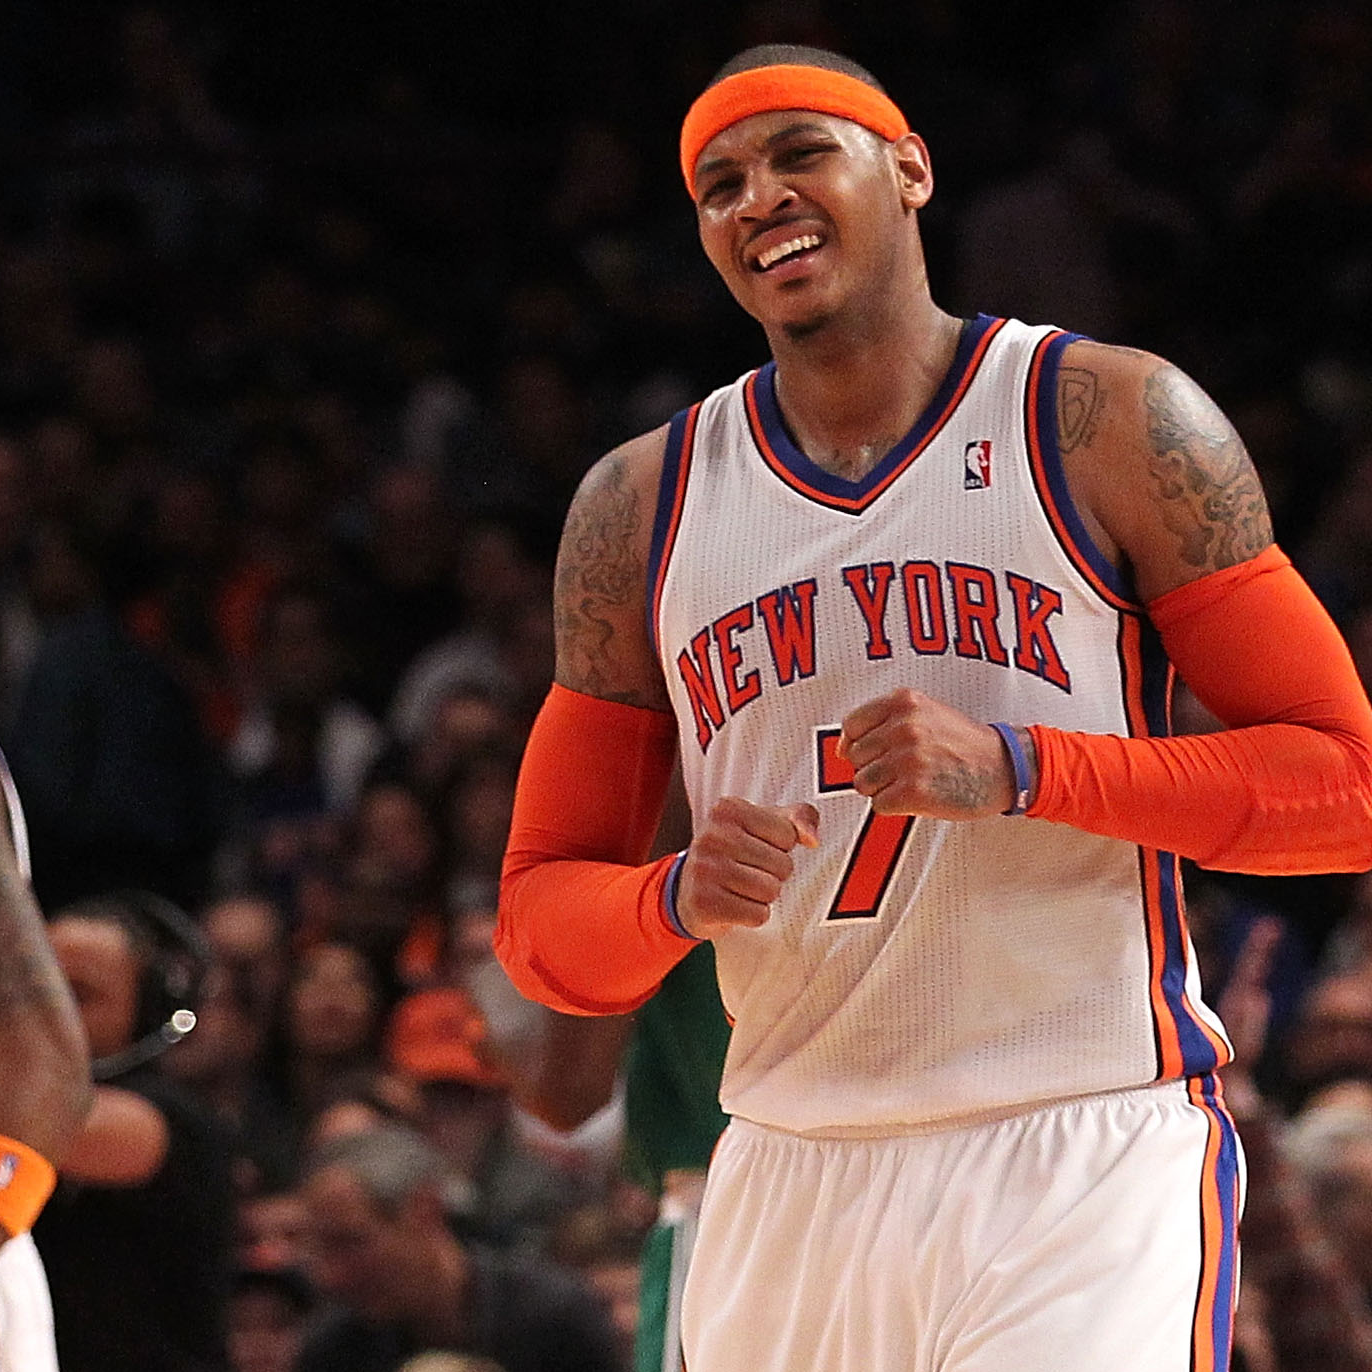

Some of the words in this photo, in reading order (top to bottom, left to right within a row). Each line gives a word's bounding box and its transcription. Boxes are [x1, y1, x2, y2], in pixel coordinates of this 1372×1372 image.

[677, 577, 818, 755] NEW
[841, 559, 1072, 695] YORK
[813, 722, 919, 925] 7
